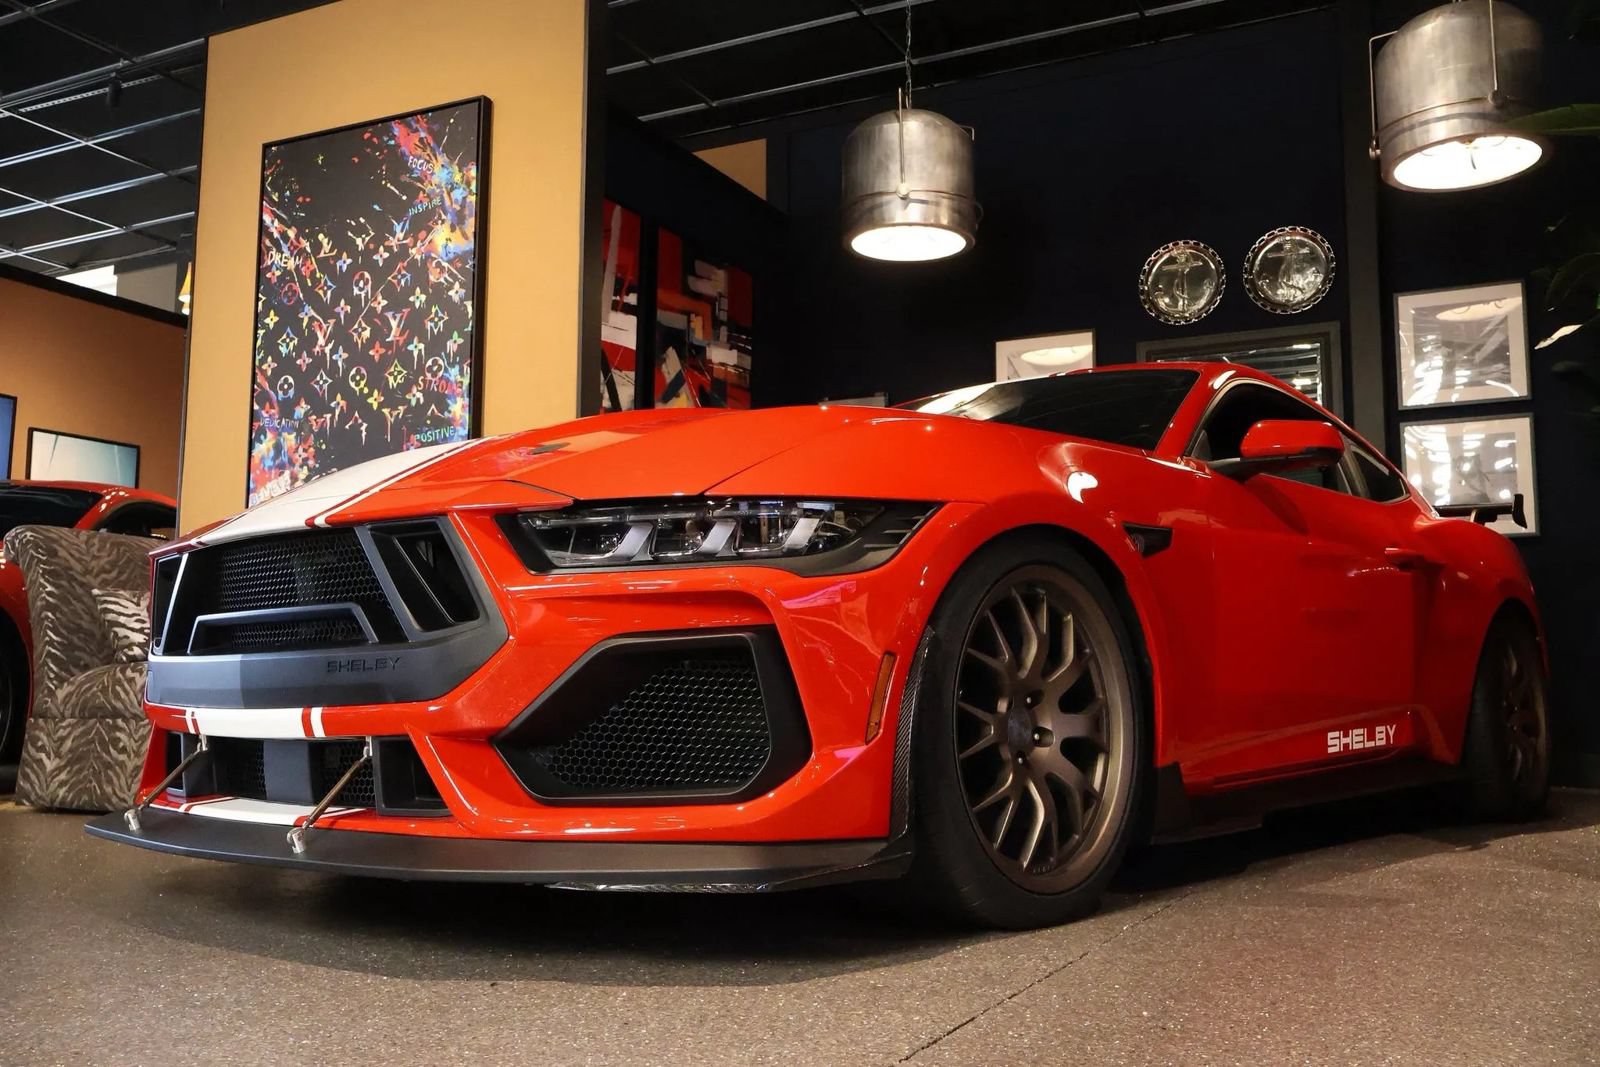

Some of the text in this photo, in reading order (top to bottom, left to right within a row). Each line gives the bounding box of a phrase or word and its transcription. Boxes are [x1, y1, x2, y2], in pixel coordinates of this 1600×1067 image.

[408, 155, 434, 174] FOCUS
[408, 196, 442, 216] INSPIRE
[414, 425, 456, 442] POSITIVE
[327, 656, 400, 673] SHELBY
[1327, 724, 1396, 754] SHELBY
